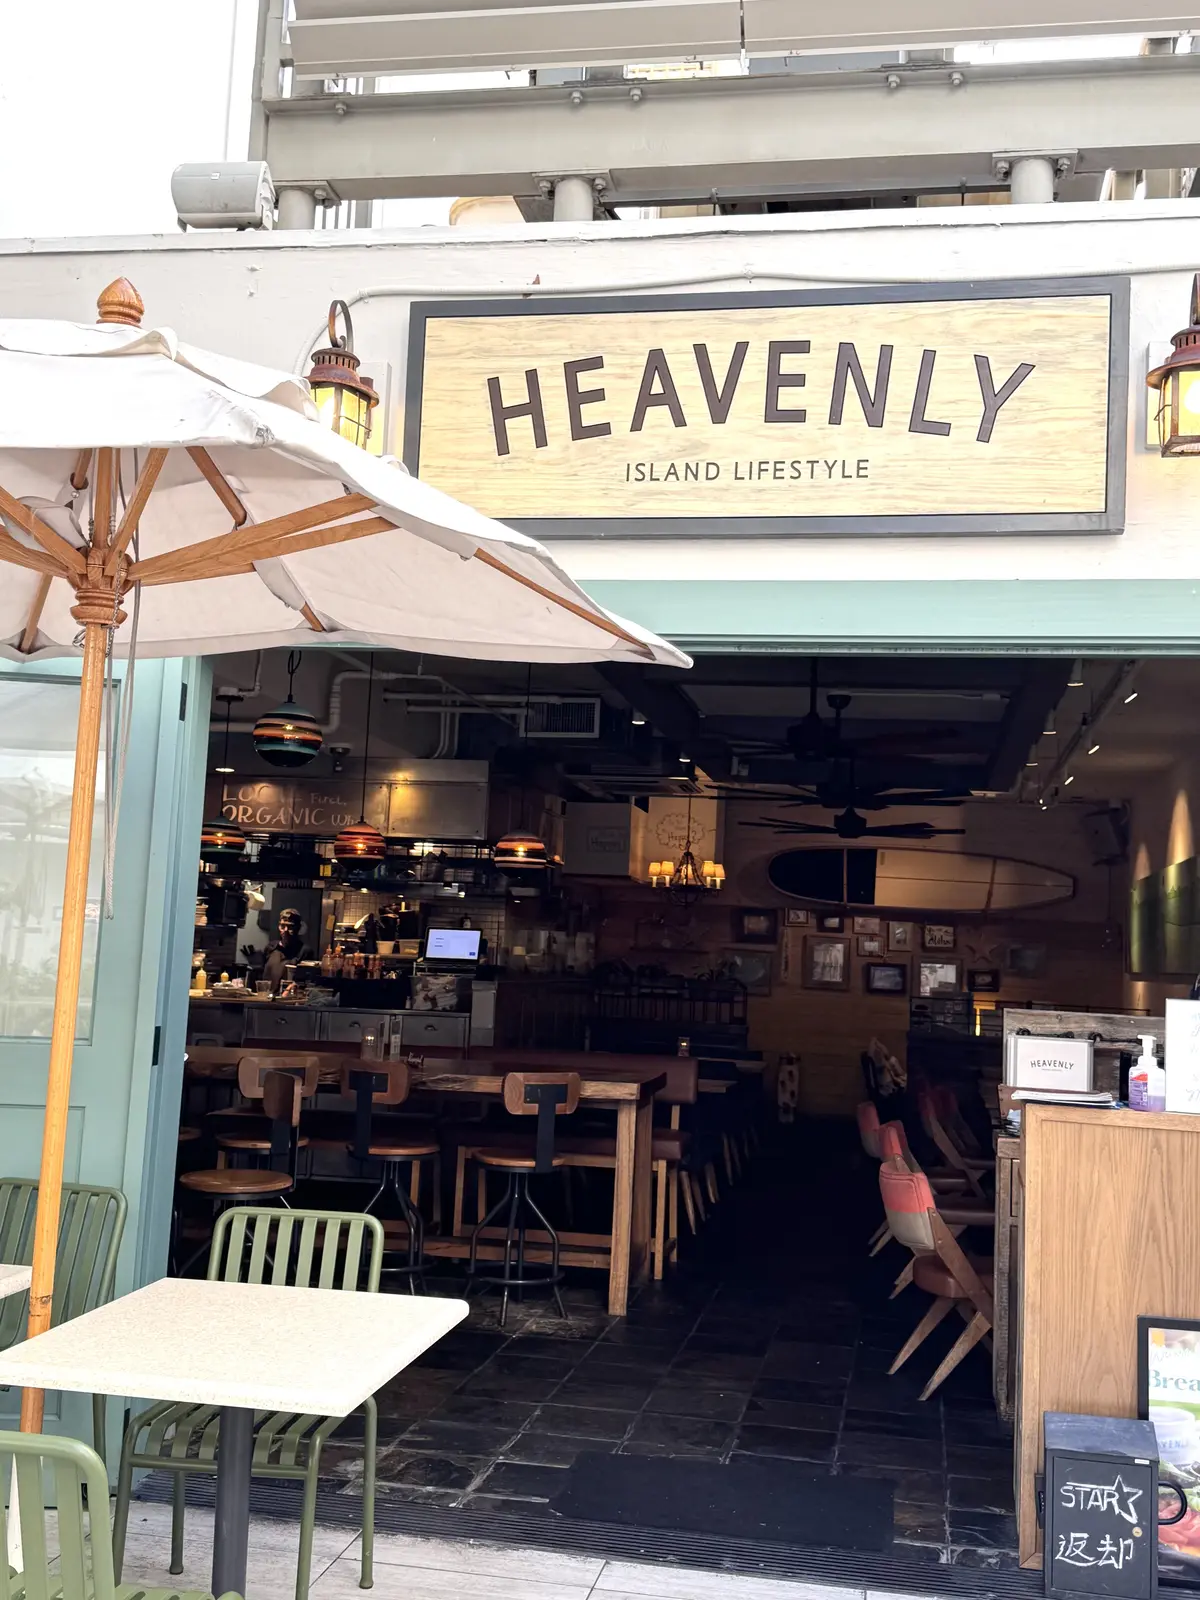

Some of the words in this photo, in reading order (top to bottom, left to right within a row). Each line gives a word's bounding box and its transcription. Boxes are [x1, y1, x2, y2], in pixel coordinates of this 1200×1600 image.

[487, 340, 1036, 456] HEAVENLY
[625, 461, 721, 482] ISLAND
[734, 459, 869, 480] LIFESTYLE
[1030, 1059, 1074, 1070] HEAVENLY
[1055, 1532, 1134, 1569] 返却
